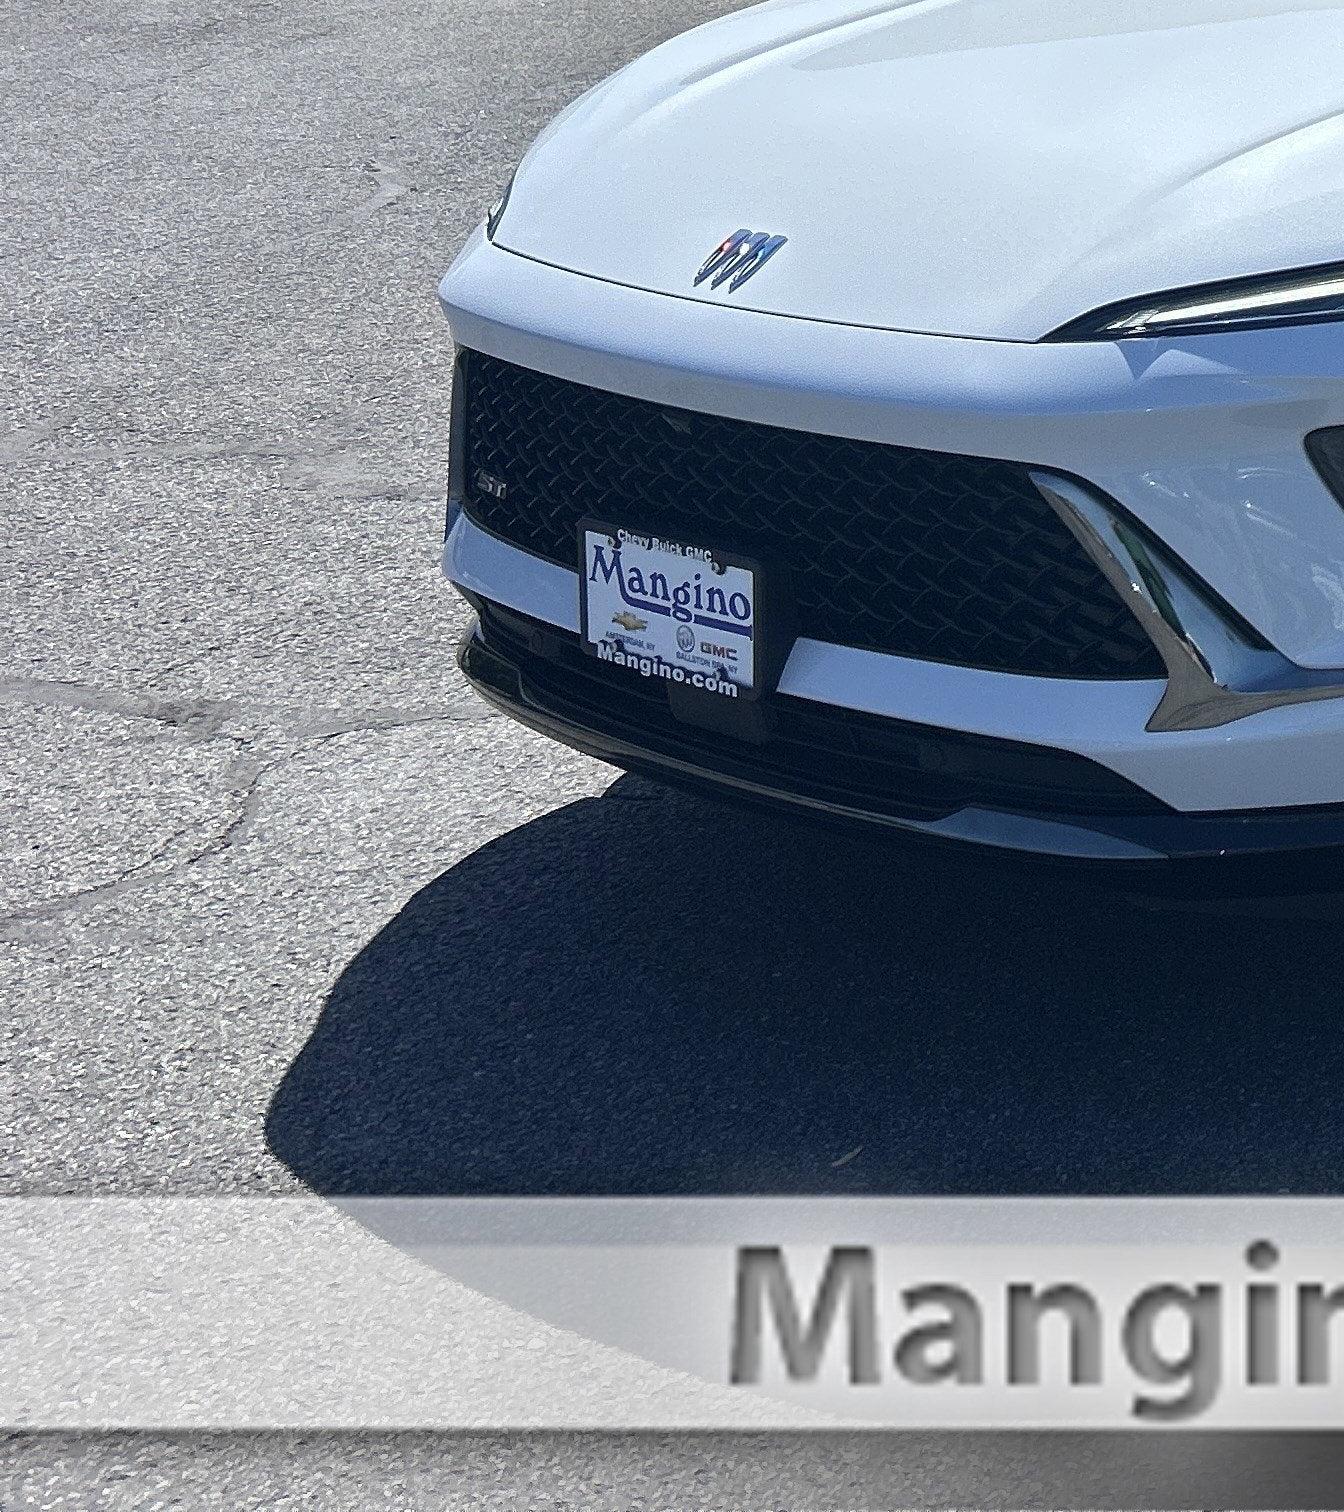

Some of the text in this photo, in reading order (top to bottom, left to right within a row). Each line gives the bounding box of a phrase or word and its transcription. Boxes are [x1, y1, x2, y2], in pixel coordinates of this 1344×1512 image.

[617, 529, 713, 563] Chevy Buick GMC
[588, 544, 752, 624] Mangino
[597, 641, 738, 698] Mangino.com
[700, 641, 739, 661] GMC
